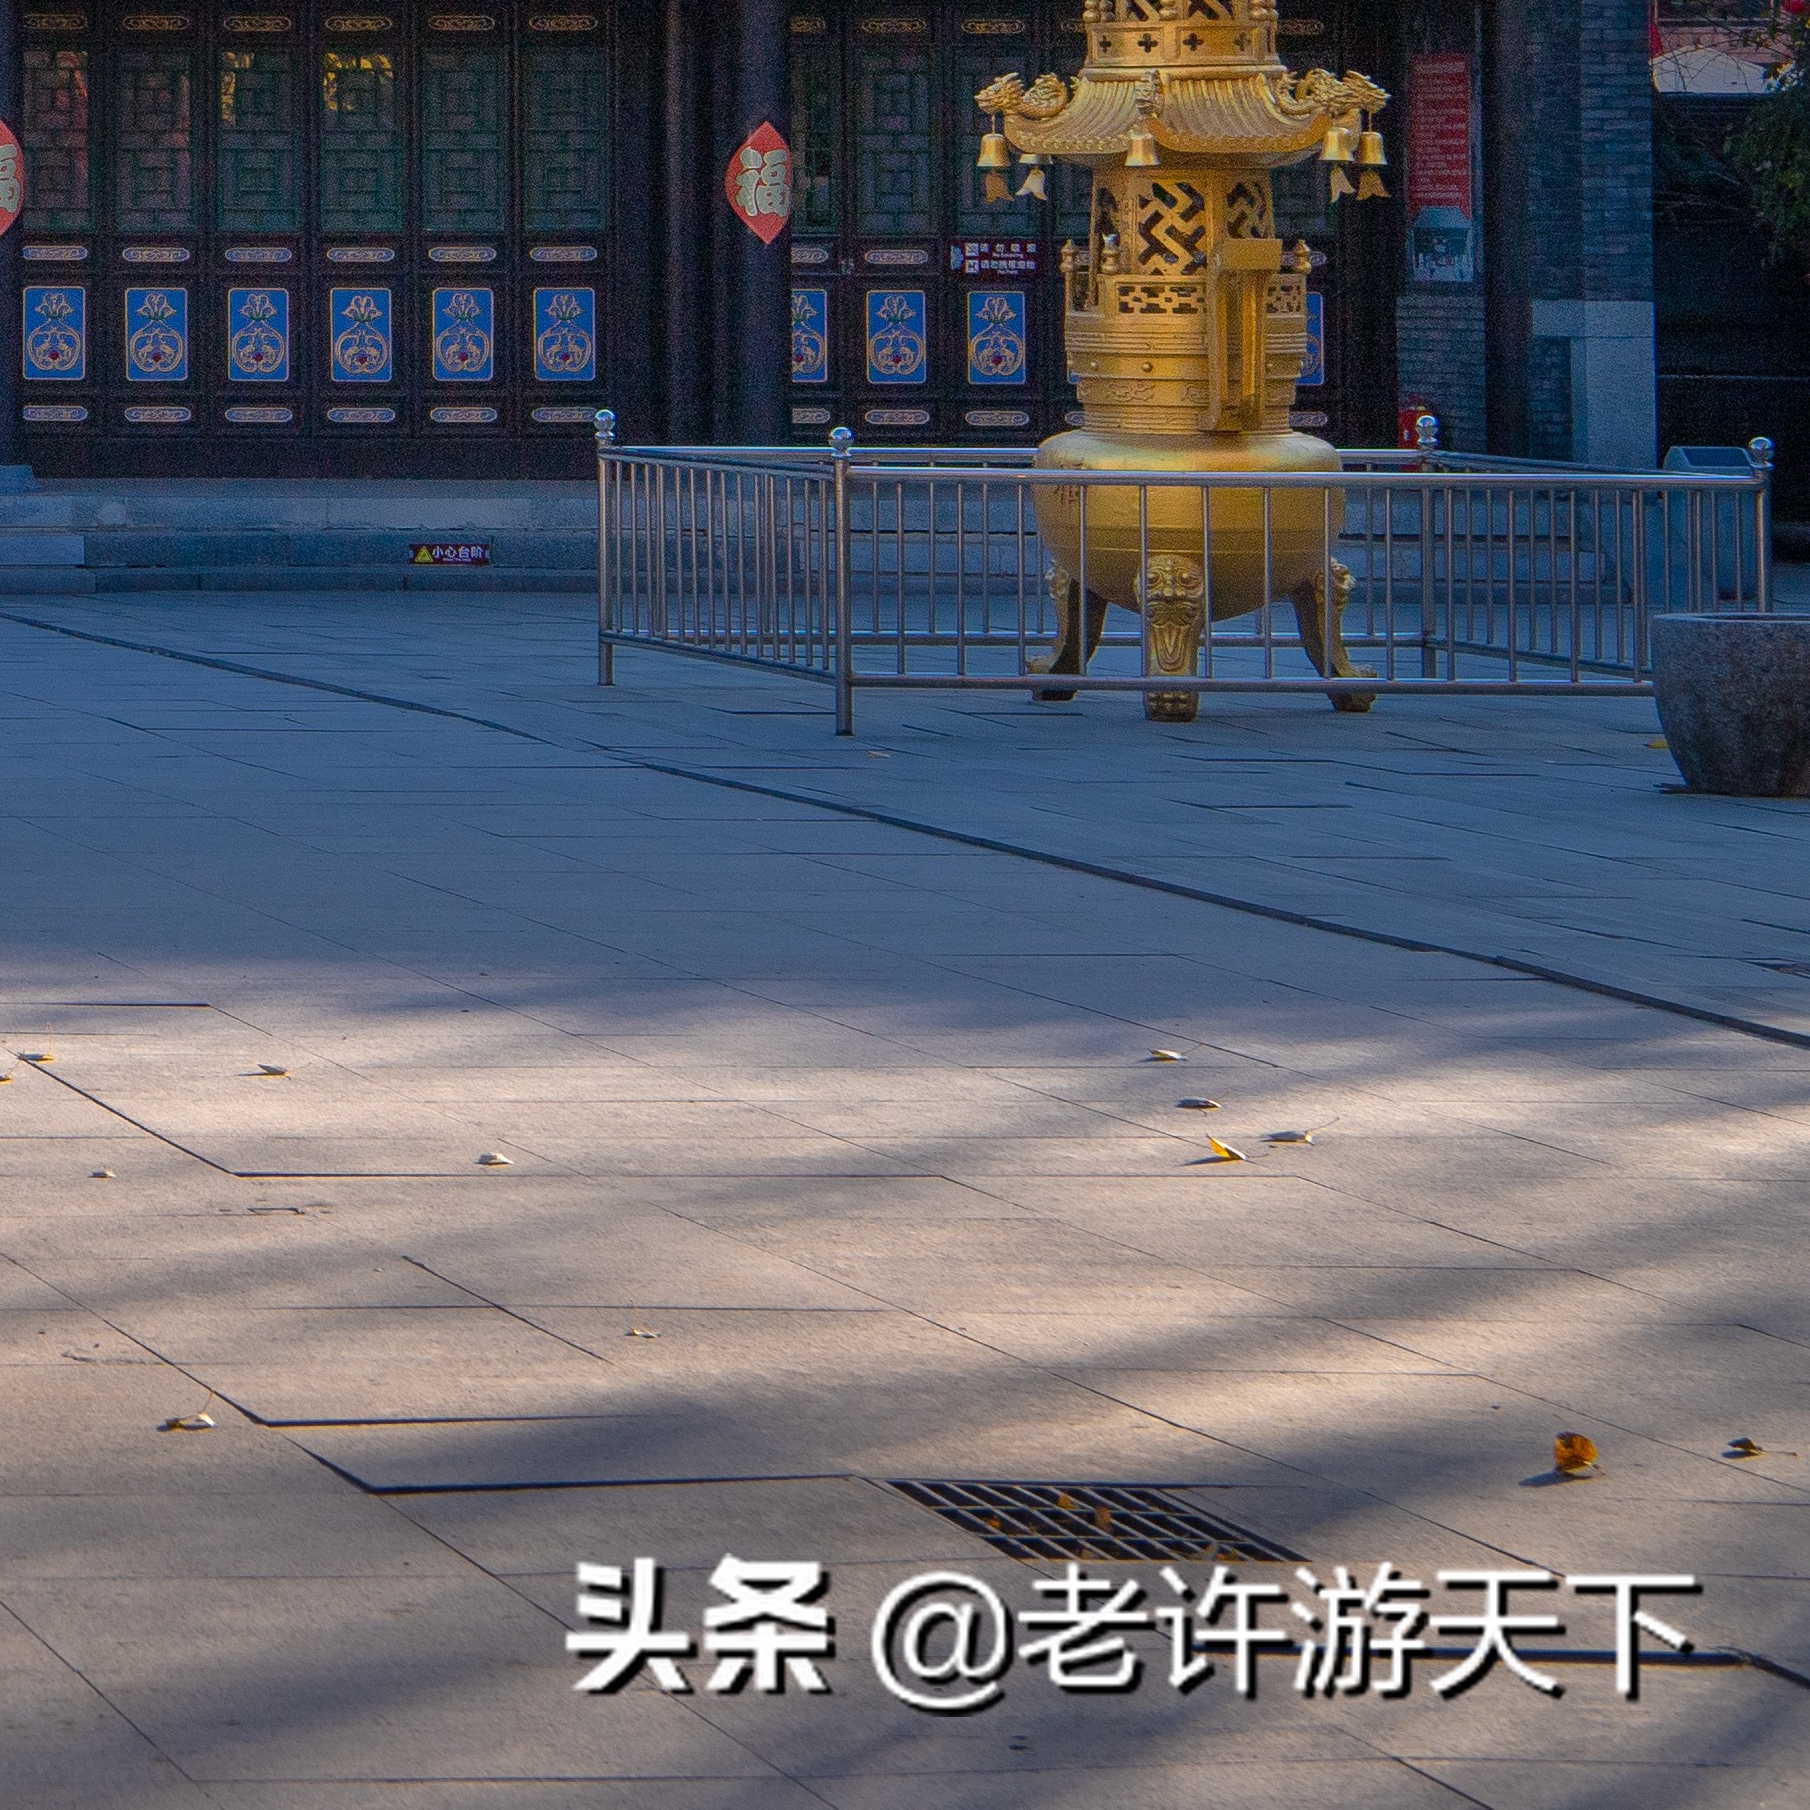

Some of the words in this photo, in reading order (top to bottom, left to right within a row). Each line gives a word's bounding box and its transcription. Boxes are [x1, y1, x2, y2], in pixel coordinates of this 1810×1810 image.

[735, 146, 791, 218] 福
[432, 545, 484, 559] 小心台阶
